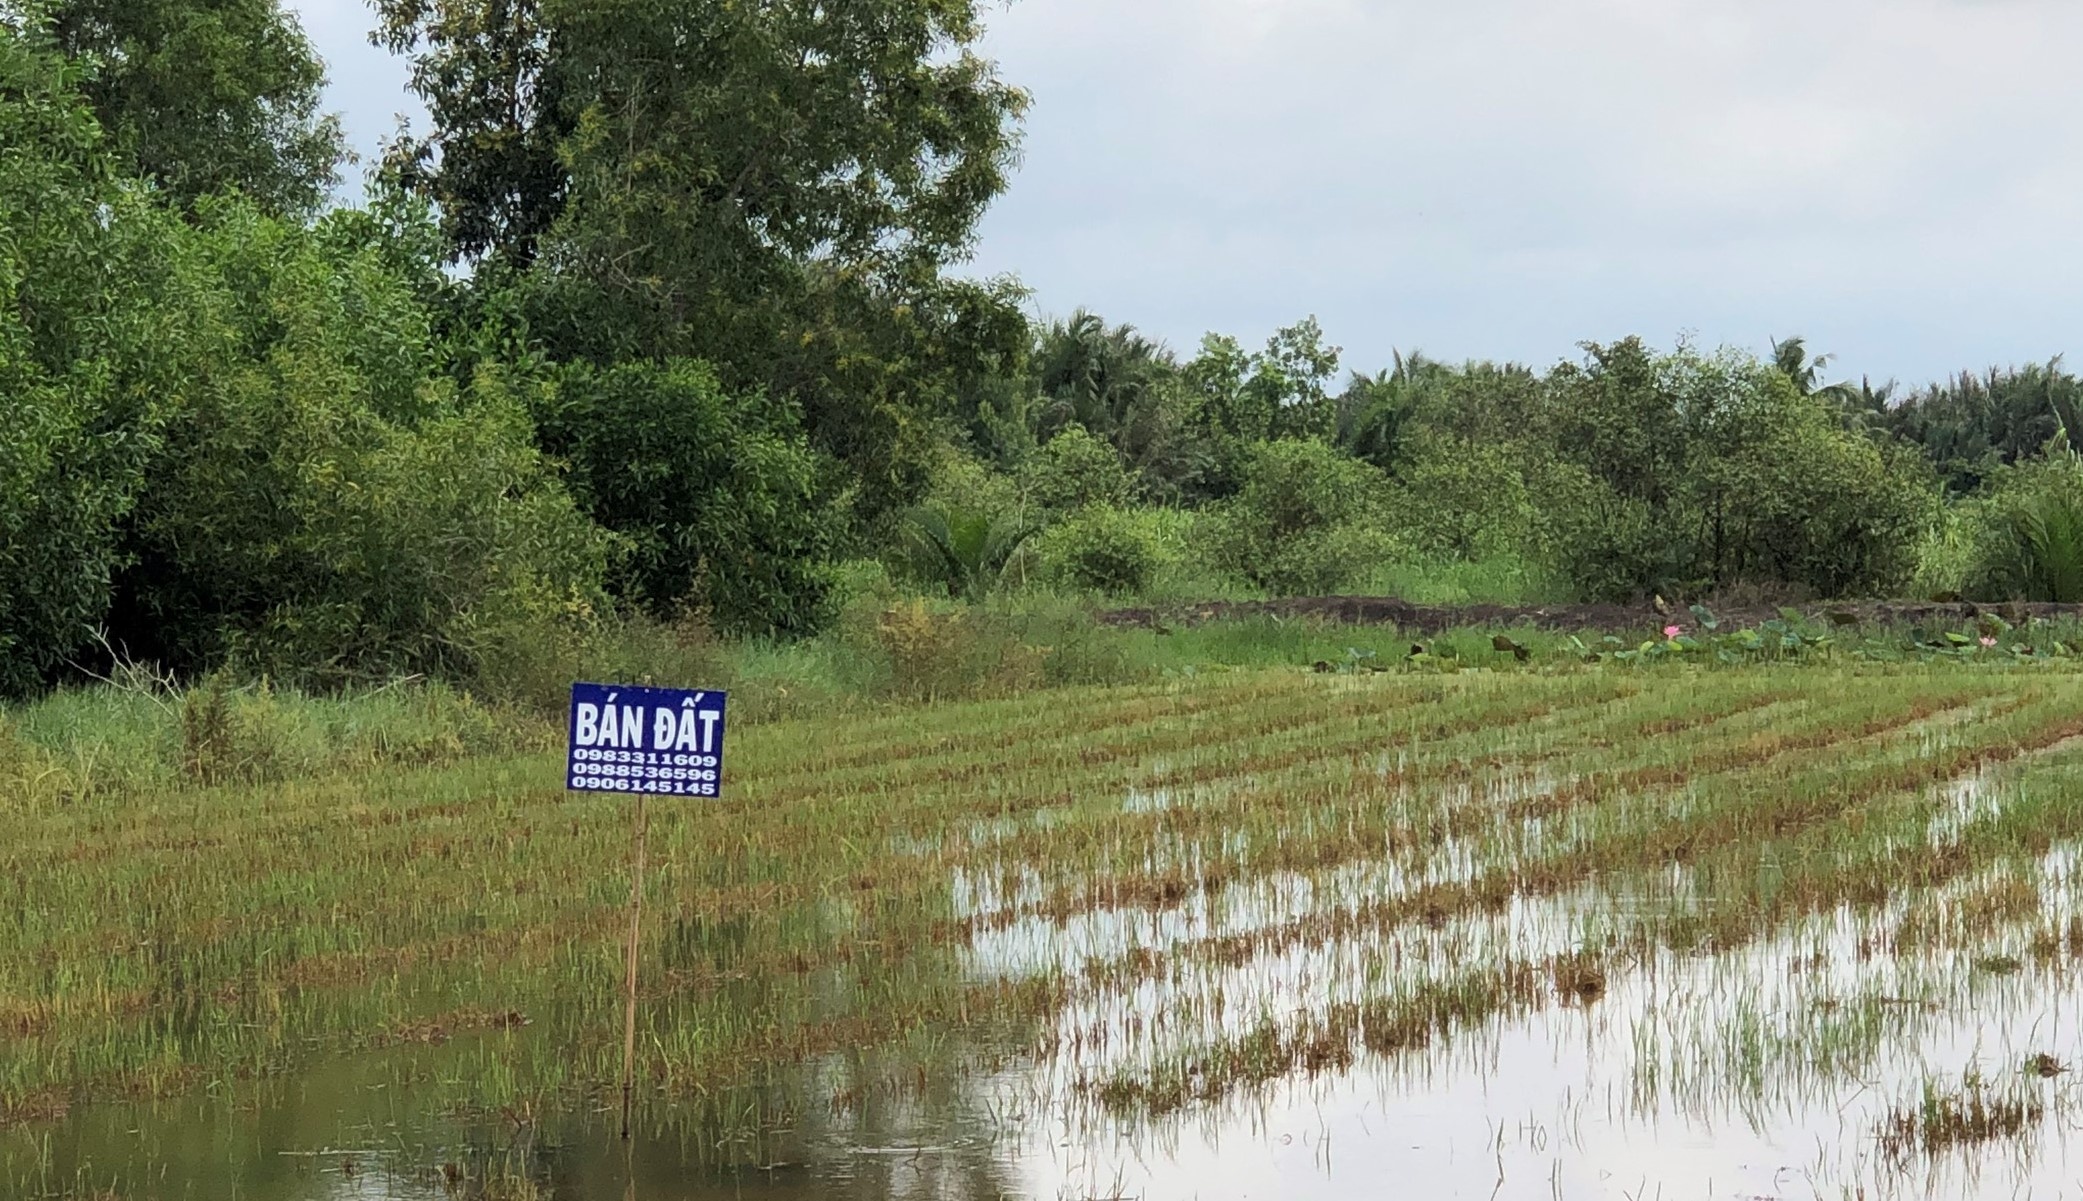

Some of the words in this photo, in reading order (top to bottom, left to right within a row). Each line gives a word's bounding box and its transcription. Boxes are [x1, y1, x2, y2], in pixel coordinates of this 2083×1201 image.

[576, 692, 644, 748] BÁN
[653, 692, 720, 752] ĐẤT
[572, 762, 716, 781] 0988536596
[572, 776, 715, 795] 0906145145
